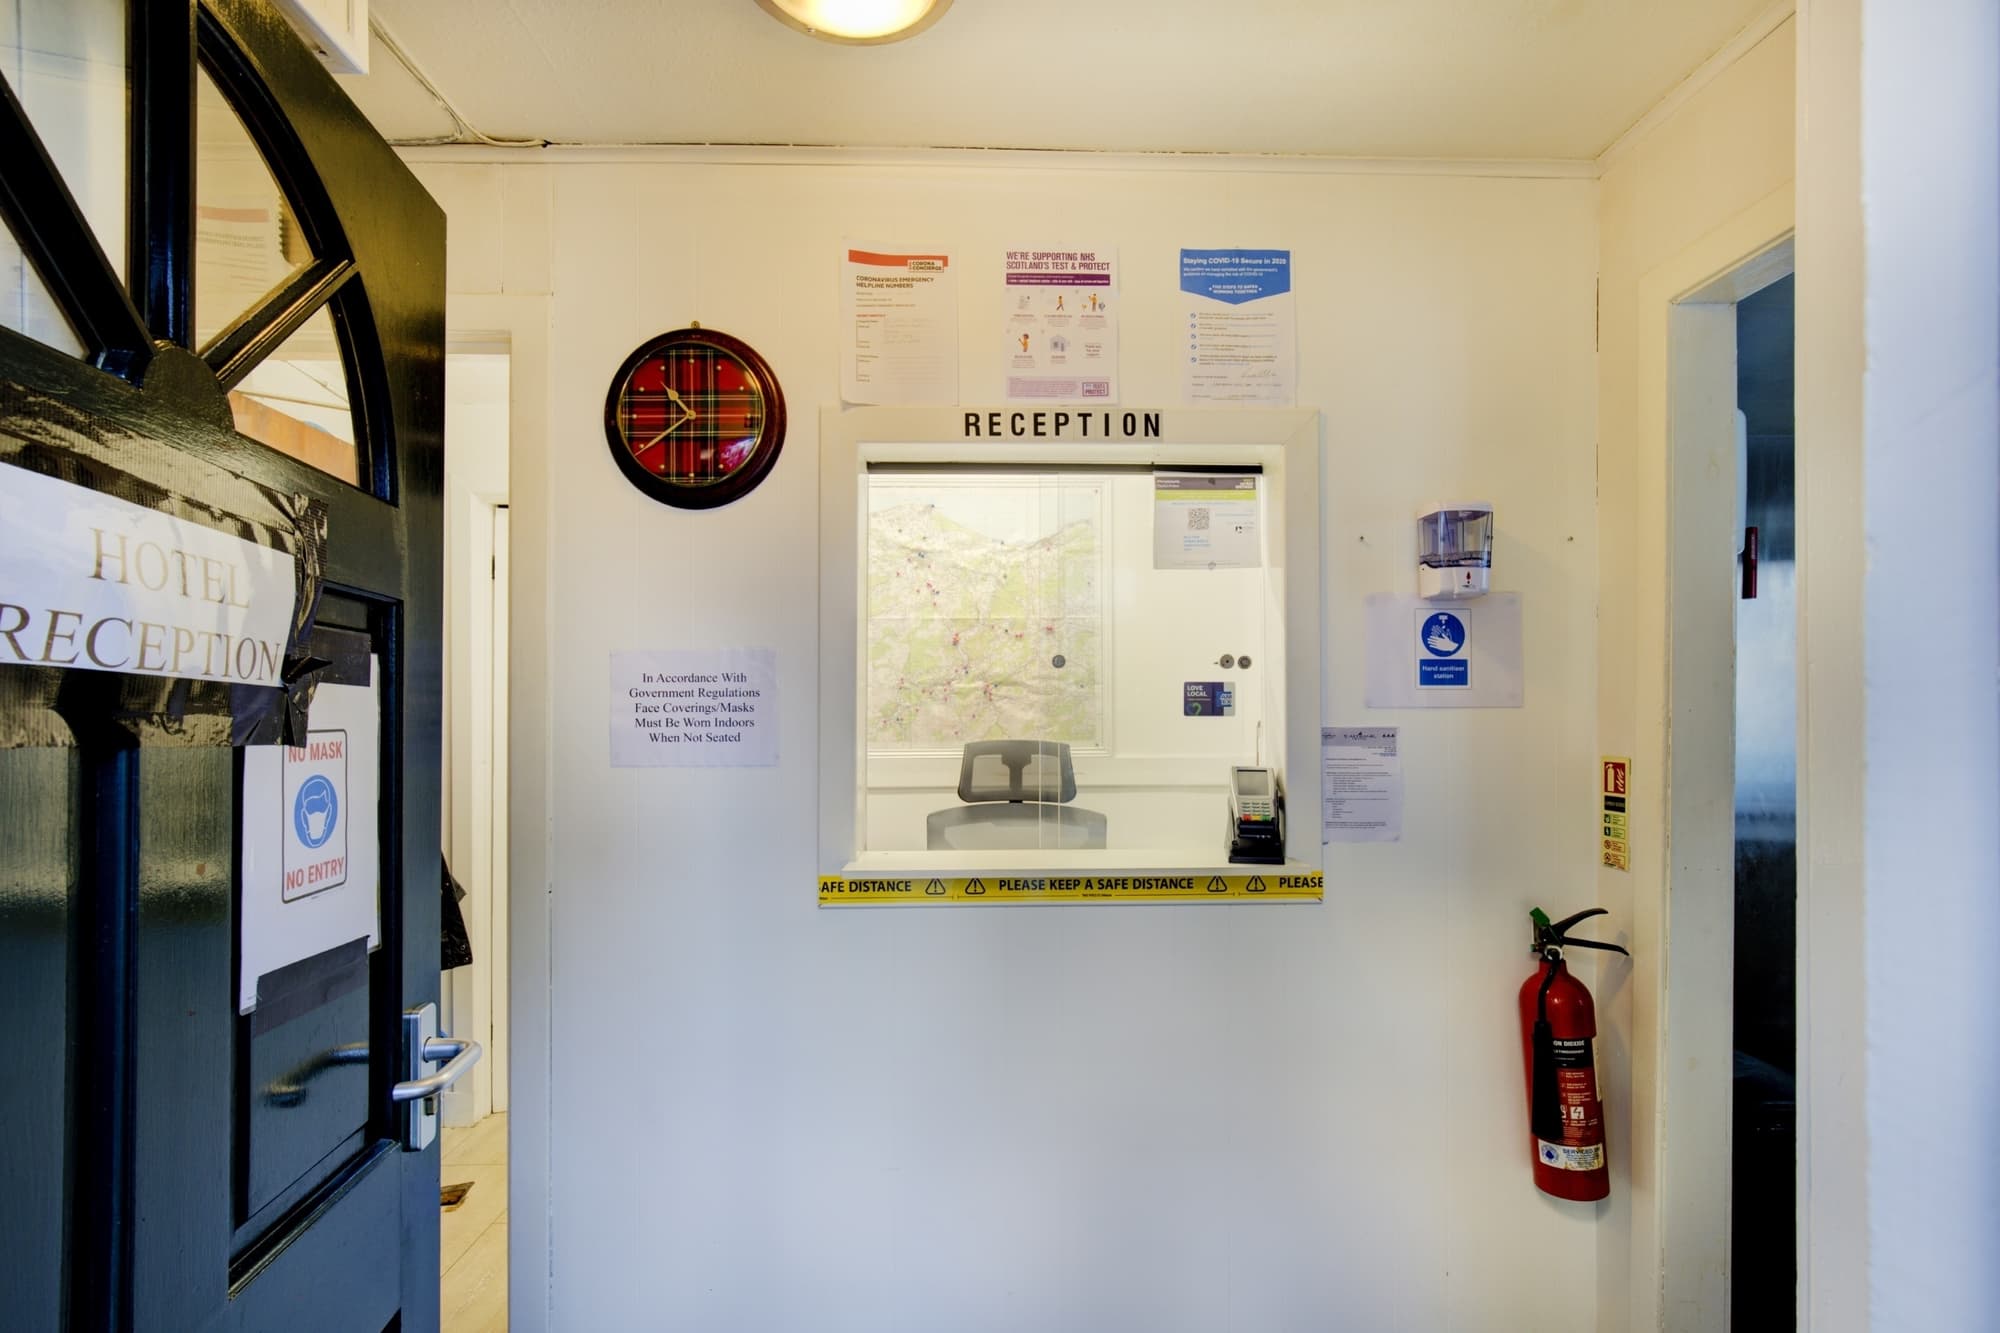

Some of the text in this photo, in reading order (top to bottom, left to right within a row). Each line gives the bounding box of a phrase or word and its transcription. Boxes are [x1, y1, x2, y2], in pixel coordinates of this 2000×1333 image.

[1006, 251, 1096, 261] WE'RE SUPPORTING NHS
[1183, 257, 1207, 265] Staying
[1006, 261, 1110, 271] SCOTLAND'S TEST & PROTECT
[856, 275, 898, 283] CORONAVIRUS
[964, 412, 1160, 437] RECEPTION
[88, 527, 250, 609] HOTEL
[0, 603, 282, 682] RECEPTION
[642, 672, 747, 683] In Accordance With
[629, 688, 761, 700] Government Regulations
[635, 702, 755, 715] Face Coverings/Masks
[634, 717, 755, 728] Must Be Worn Indoors
[649, 732, 741, 743] When Not Seated
[288, 741, 343, 763] NO MASK
[286, 857, 345, 890] NO ENTRY
[819, 880, 912, 893] AFE DISTANCE
[999, 878, 1194, 891] PLEASE KEEP A SAFE DISTANCE
[1279, 876, 1323, 889] PLEASE
